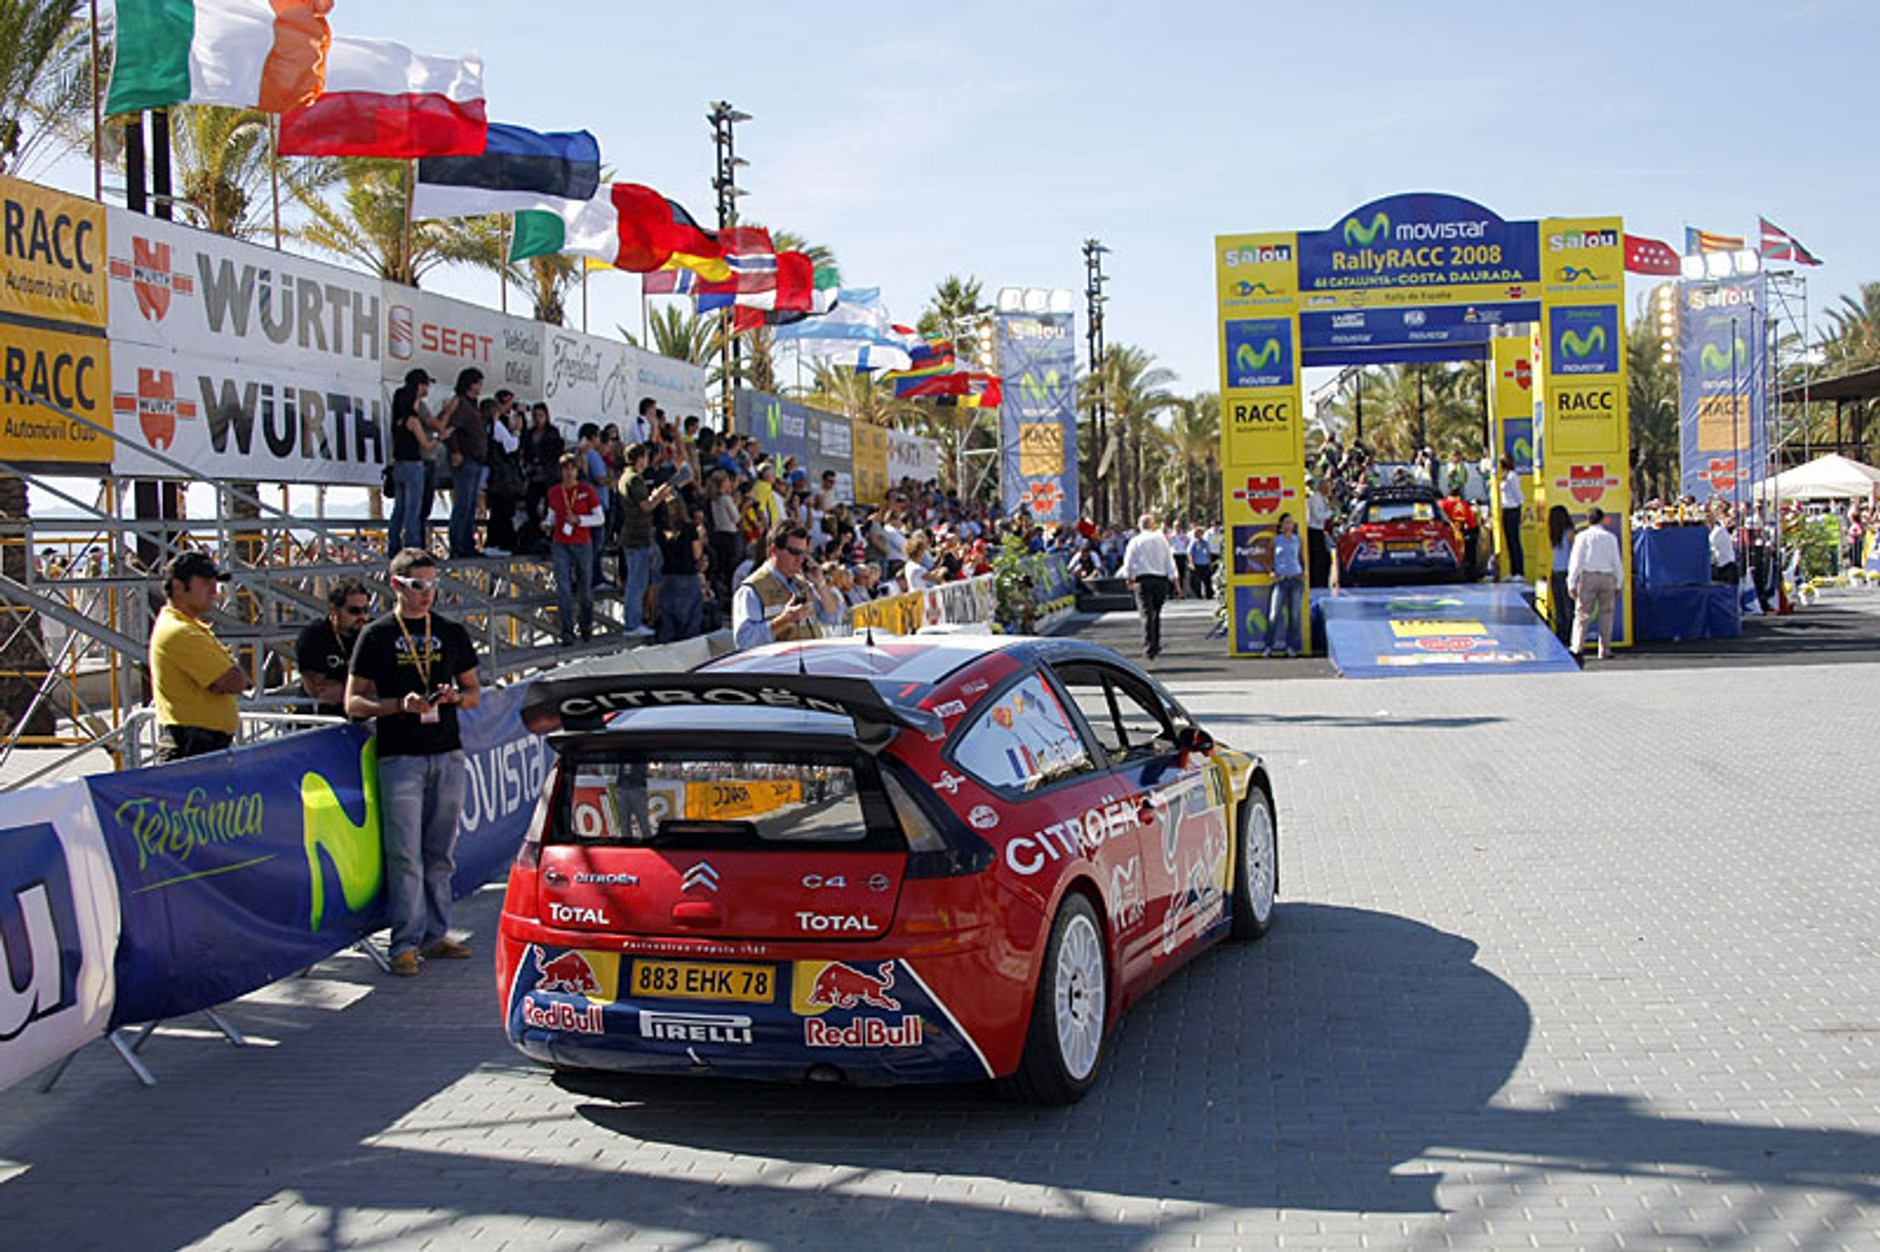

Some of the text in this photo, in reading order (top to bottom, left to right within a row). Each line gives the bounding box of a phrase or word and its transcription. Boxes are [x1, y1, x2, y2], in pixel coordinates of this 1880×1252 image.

[5, 199, 94, 274] RACC
[1395, 220, 1489, 241] movistar
[1332, 245, 1502, 273] RallyRACC 2008
[1450, 269, 1523, 282] DAURADA
[71, 281, 96, 306] Club
[196, 252, 380, 361] WÜRTH
[421, 323, 496, 363] SEAT
[6, 346, 96, 411] RACC
[1235, 403, 1288, 423] RACC
[1558, 391, 1613, 411] RACC
[70, 421, 97, 441] Club
[197, 375, 385, 465] WÜRTH
[559, 687, 847, 716] CITROËN
[116, 786, 264, 873] Telefónica
[1006, 794, 1143, 875] CITROËN
[802, 873, 847, 889] C4
[639, 965, 768, 996] 883 EHK 78
[522, 996, 605, 1035] Red Bull
[639, 1010, 752, 1044] PIRELLI
[805, 1015, 922, 1047] Red Bull
